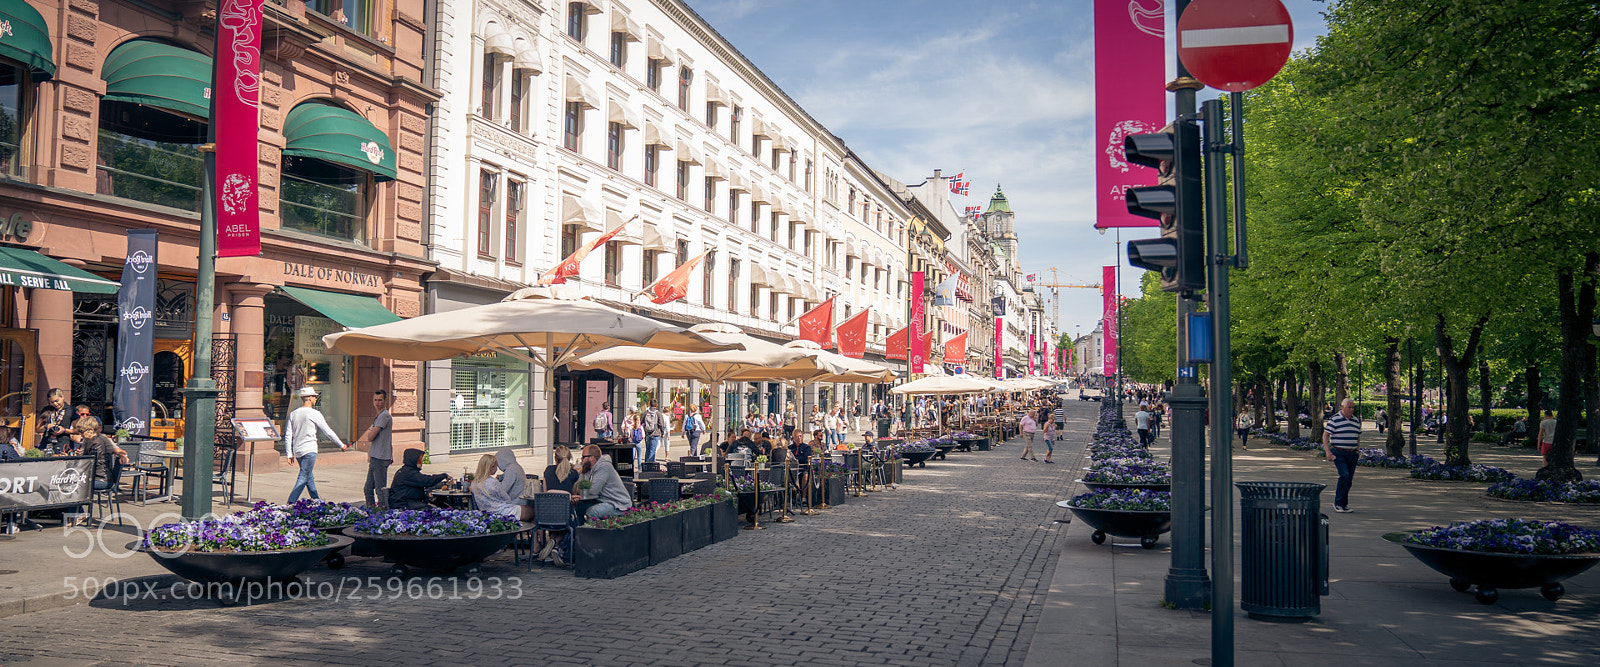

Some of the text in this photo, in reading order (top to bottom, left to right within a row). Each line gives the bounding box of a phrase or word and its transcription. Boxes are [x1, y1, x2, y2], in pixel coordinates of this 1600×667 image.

[226, 224, 252, 233] ABEL
[284, 262, 379, 287] DALE OF NORWAY
[20, 275, 51, 288] SERVE
[54, 279, 71, 290] ALL
[269, 314, 293, 324] DALE
[50, 472, 87, 484] Hard Rock
